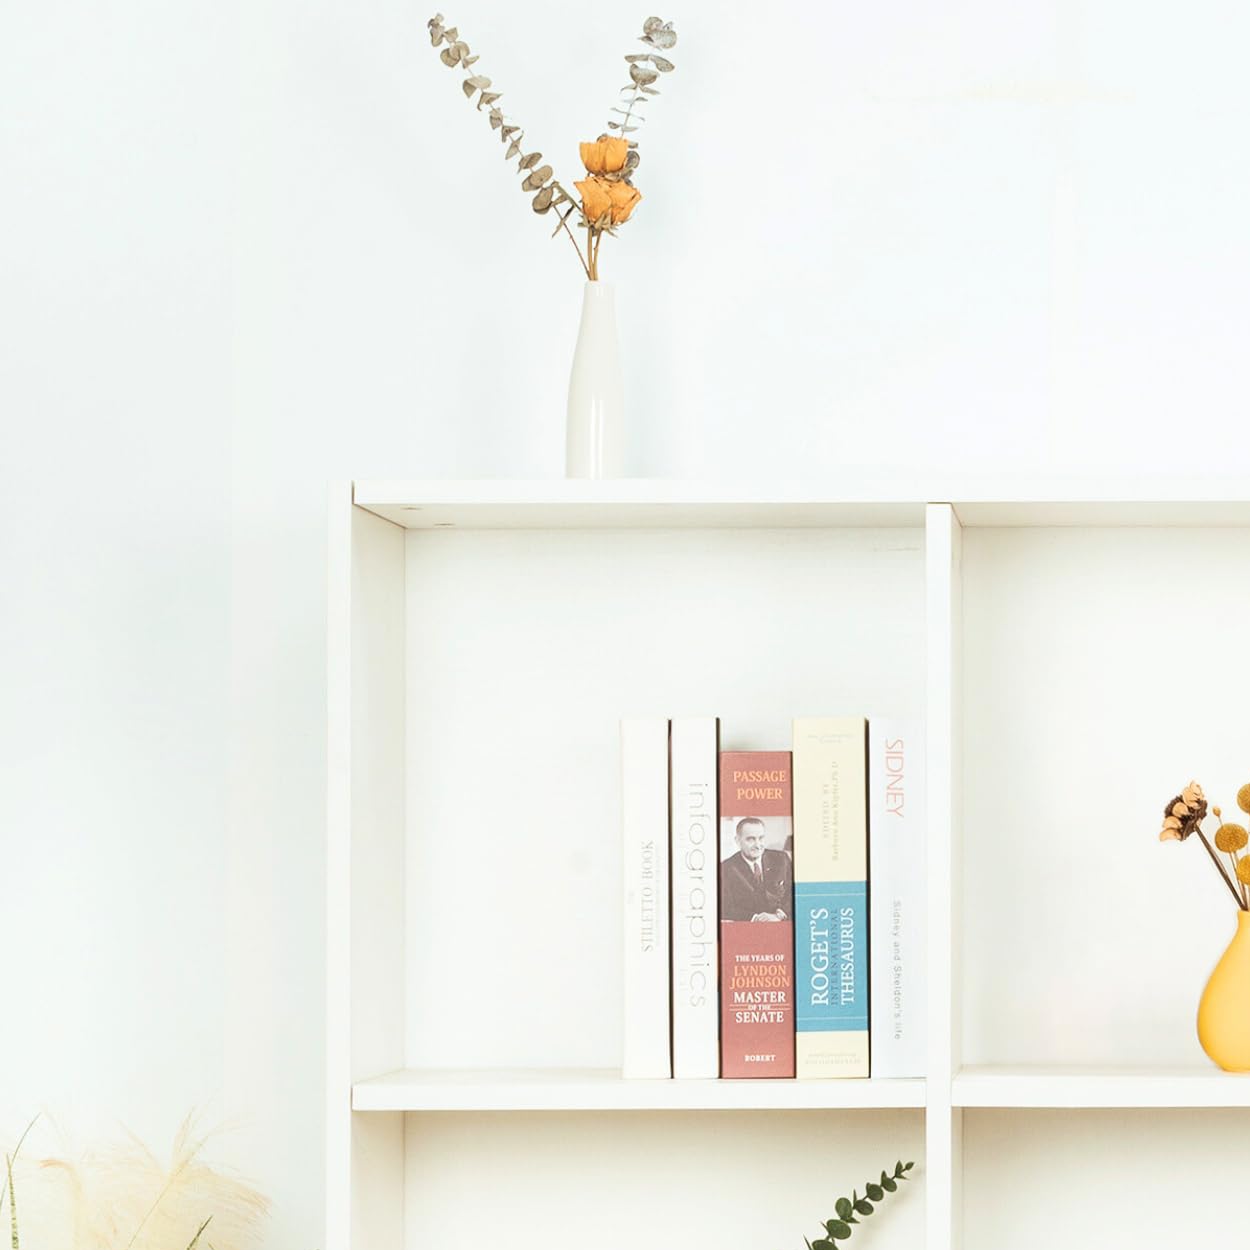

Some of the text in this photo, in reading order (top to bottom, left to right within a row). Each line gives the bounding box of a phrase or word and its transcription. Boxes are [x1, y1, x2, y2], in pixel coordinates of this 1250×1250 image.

[733, 770, 787, 783] PASSAGE
[885, 738, 904, 818] SIDNEY
[736, 788, 784, 800] POWER
[641, 840, 654, 880] BOOK
[685, 783, 714, 1008] infographics
[891, 900, 902, 937] Sidney
[810, 907, 829, 1006] ROGET'S
[840, 907, 855, 1006] THESAURUS
[893, 941, 902, 961] and
[735, 954, 785, 962] THE YEARS OF
[734, 965, 787, 977] LYNDON
[729, 976, 791, 989] JOHNSON
[733, 991, 786, 1003] MASTER
[735, 1011, 785, 1024] SENATE
[744, 1054, 777, 1063] ROBERT
